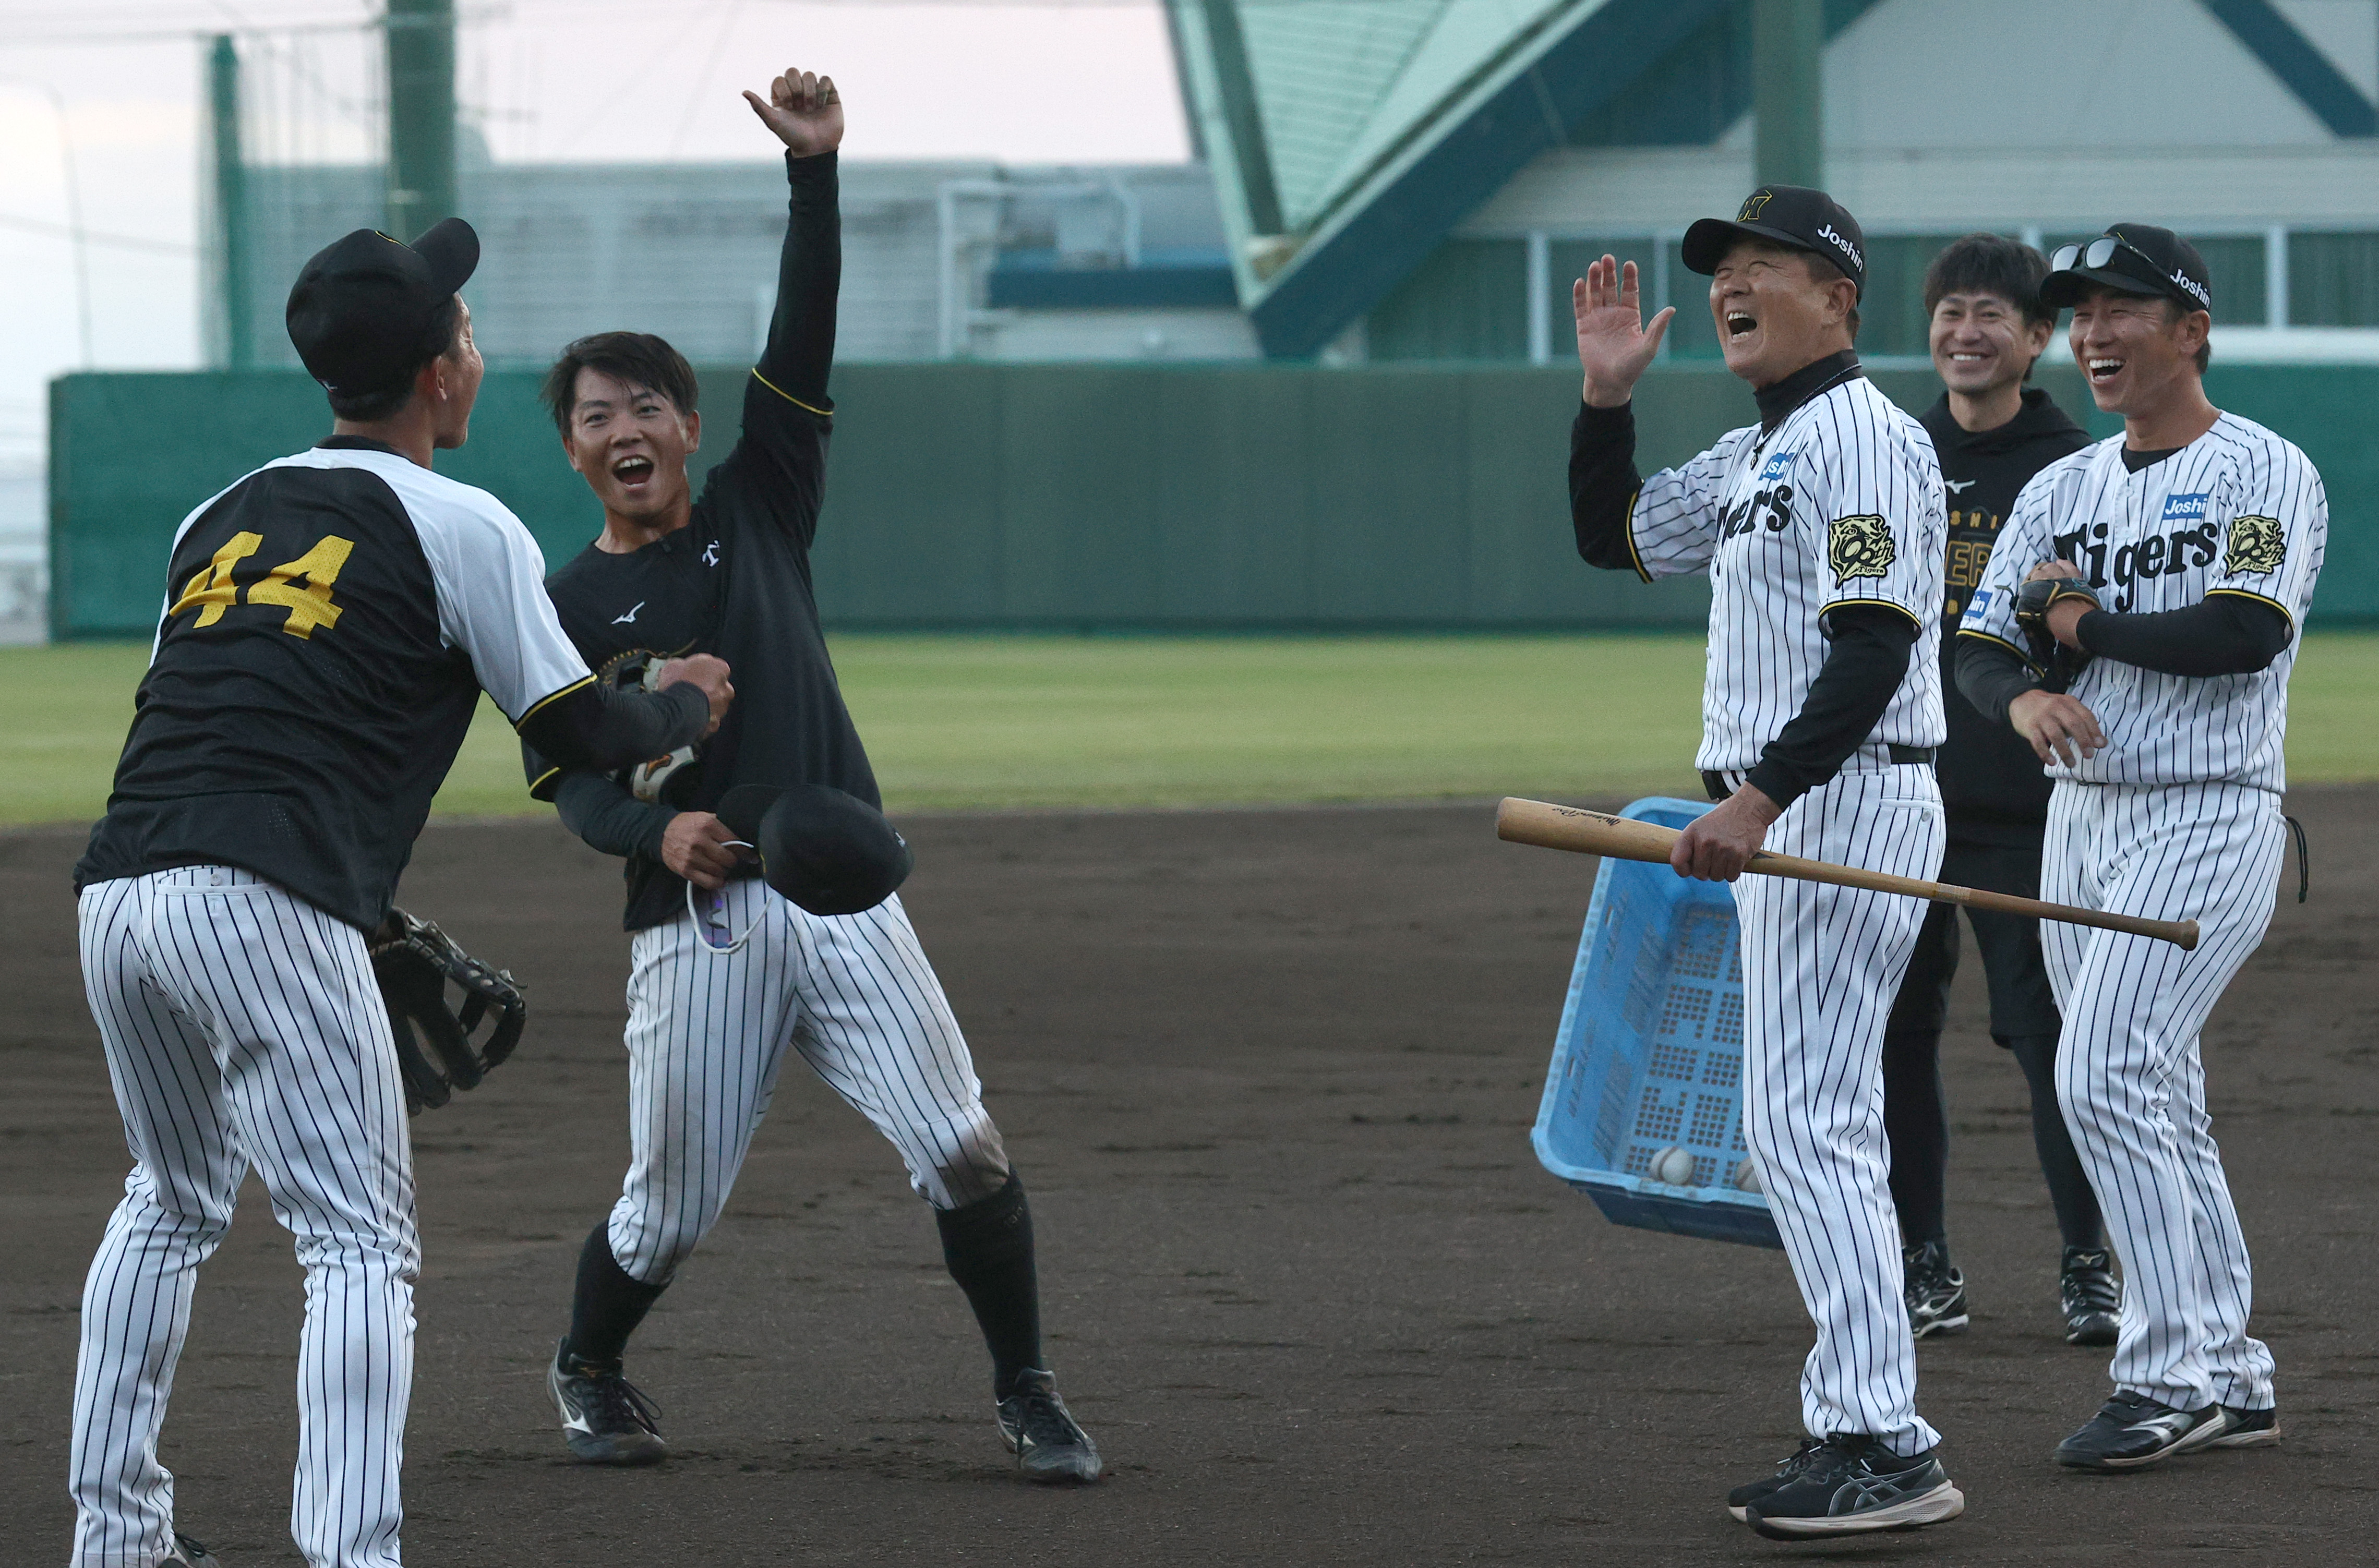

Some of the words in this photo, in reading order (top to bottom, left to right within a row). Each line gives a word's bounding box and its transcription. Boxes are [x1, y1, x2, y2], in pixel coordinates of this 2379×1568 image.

[1817, 224, 1864, 273] Joshin
[2170, 269, 2211, 308] Joshin
[169, 530, 355, 640] 44
[2053, 523, 2217, 613] Tigers
